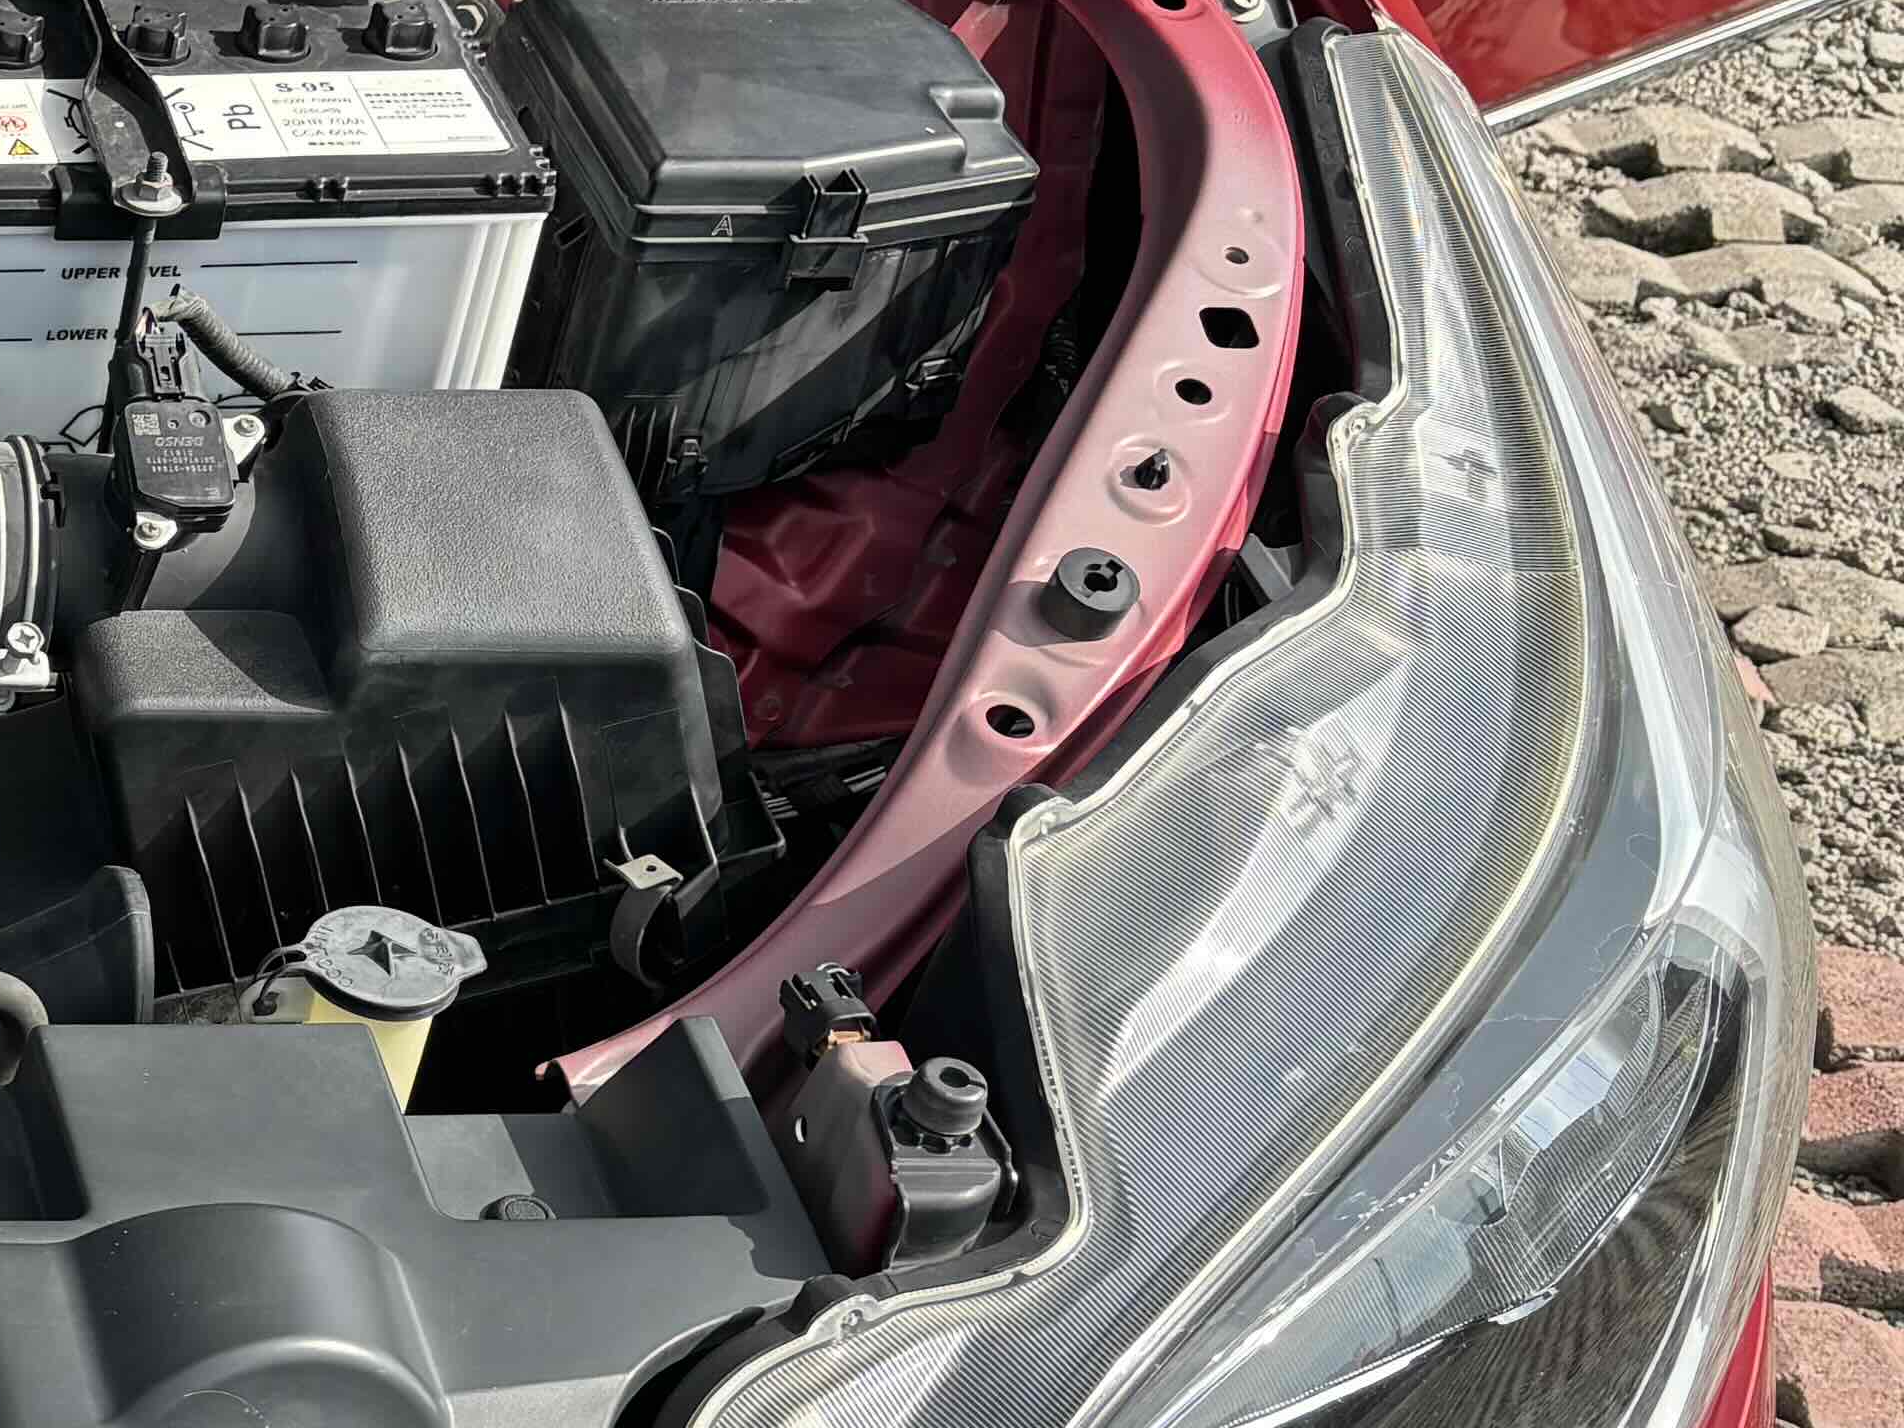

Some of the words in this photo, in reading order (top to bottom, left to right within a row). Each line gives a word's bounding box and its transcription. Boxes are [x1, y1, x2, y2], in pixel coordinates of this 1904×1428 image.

[222, 103, 262, 130] Pb
[61, 267, 121, 280] UPPER
[46, 329, 108, 341] LOWER
[154, 436, 205, 447] DENSO
